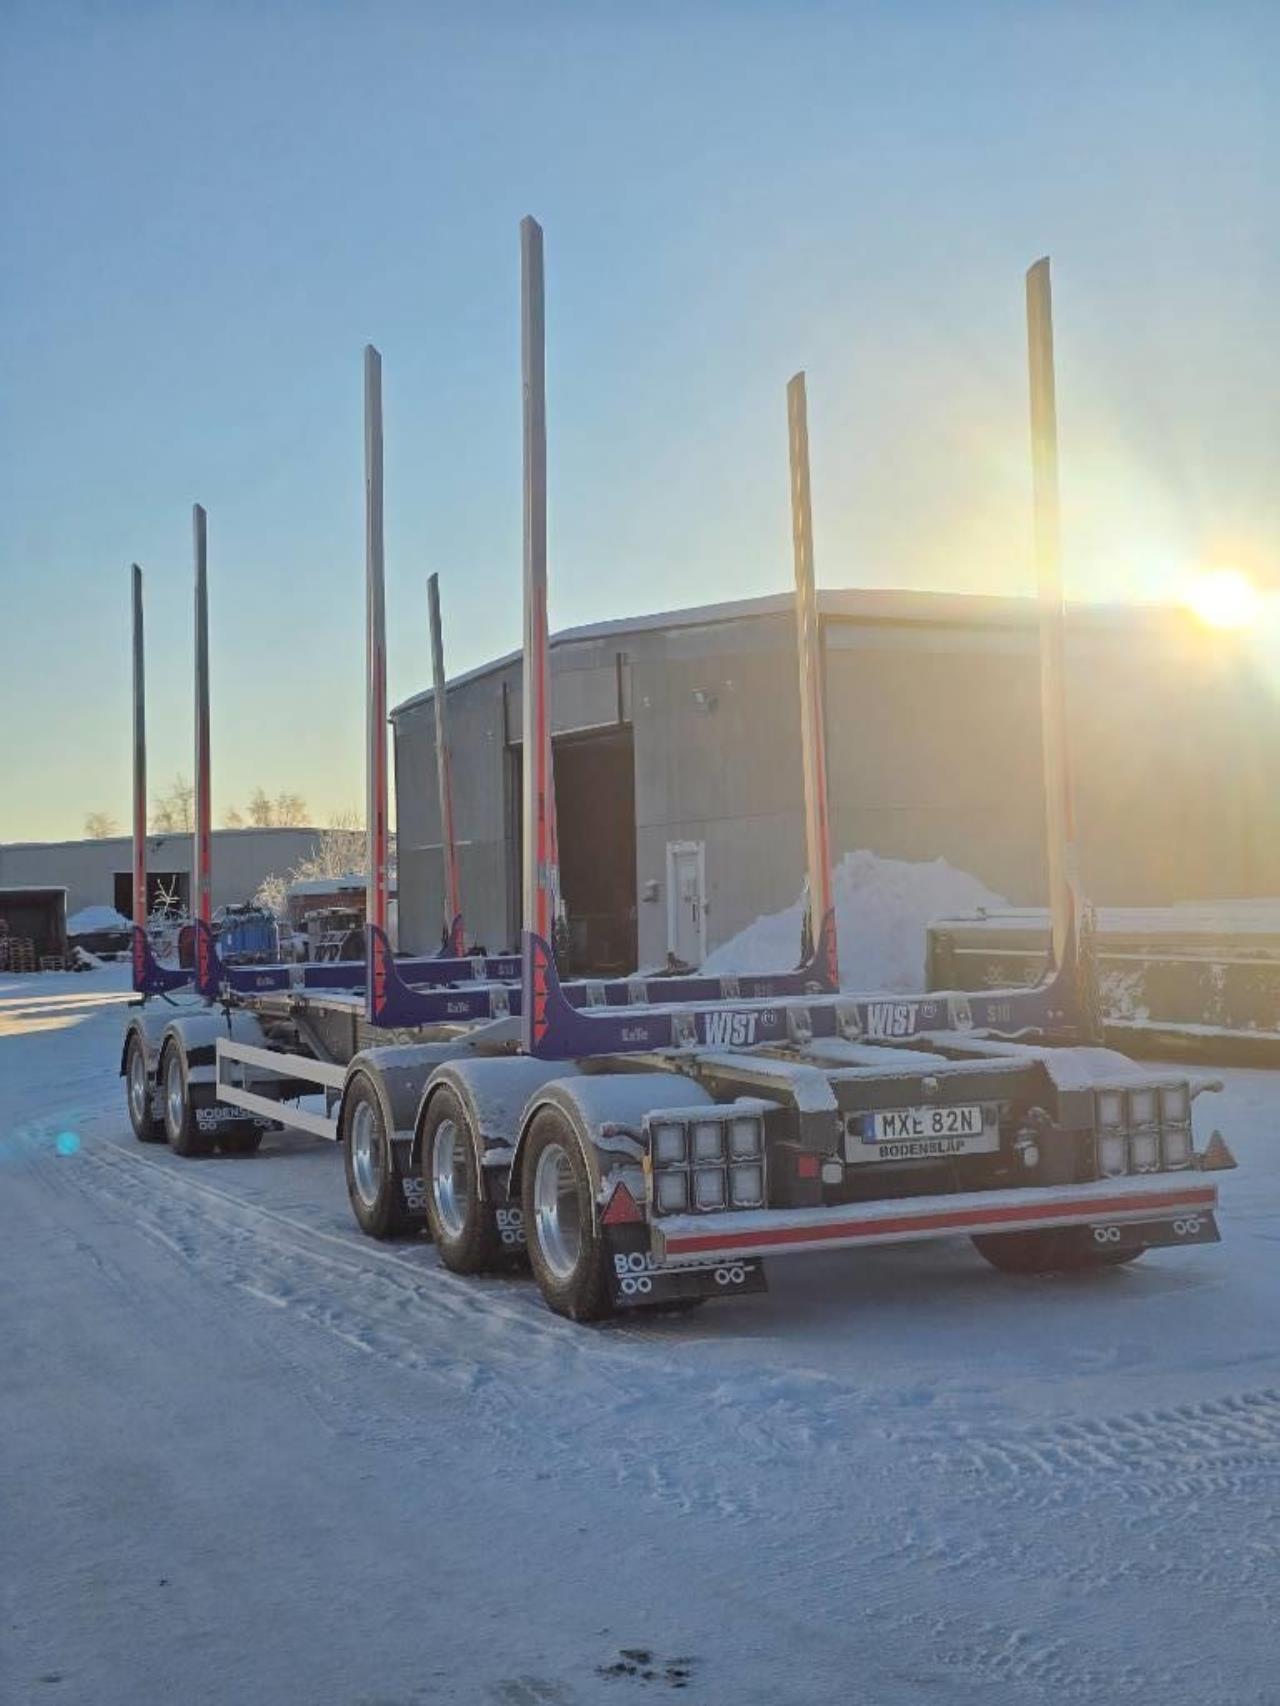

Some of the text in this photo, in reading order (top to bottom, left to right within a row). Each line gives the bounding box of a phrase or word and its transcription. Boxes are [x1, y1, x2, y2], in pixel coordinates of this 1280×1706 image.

[705, 1012, 758, 1046] WIST
[868, 1004, 918, 1038] WIST
[882, 1110, 972, 1137] MXE 82N
